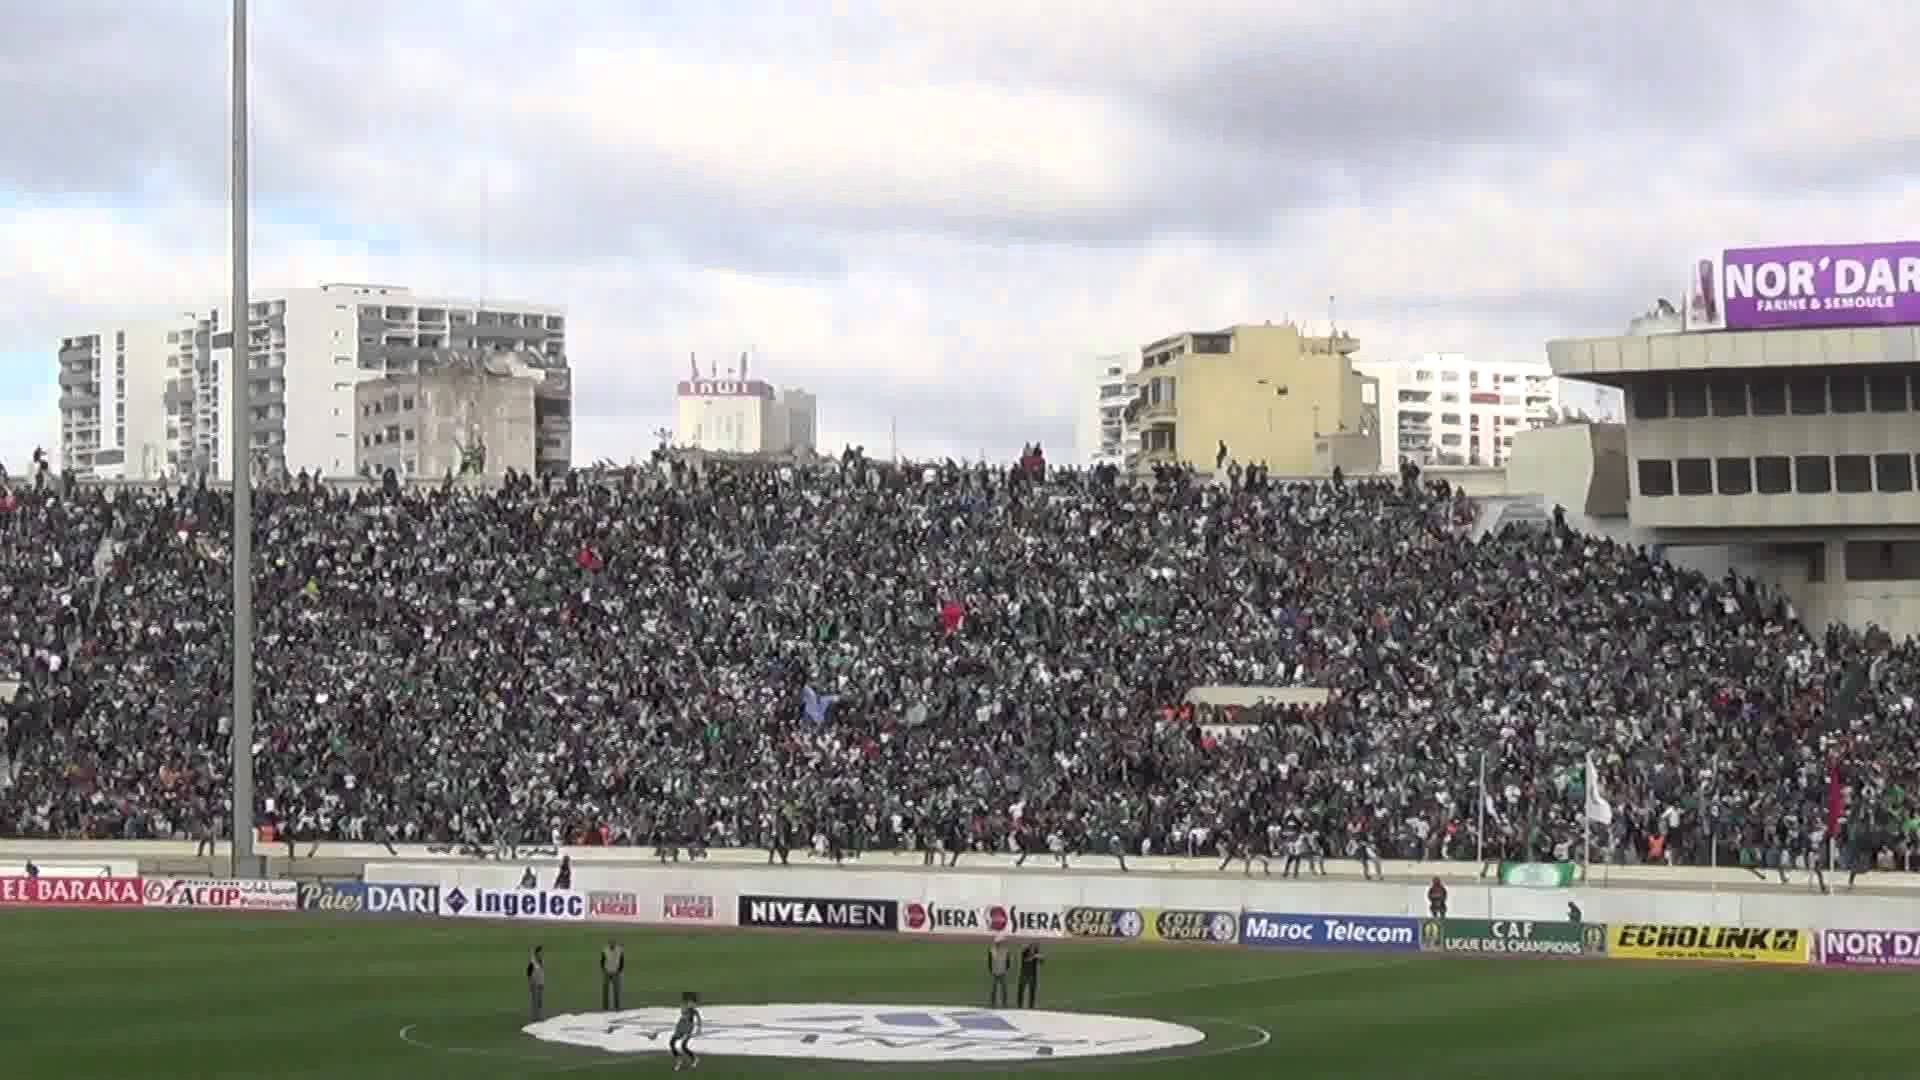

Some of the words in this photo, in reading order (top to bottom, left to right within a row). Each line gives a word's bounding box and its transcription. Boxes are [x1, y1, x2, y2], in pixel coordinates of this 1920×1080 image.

[1757, 298, 1806, 311] FARINE
[1810, 298, 1821, 310] &
[1824, 296, 1894, 310] SEMOULE
[2, 879, 31, 900] EL
[38, 879, 137, 902] BARAKA
[367, 887, 435, 912] DARI
[751, 900, 824, 924] NIVEA
[826, 904, 886, 926] MEN
[1246, 917, 1312, 940] Maroc
[1325, 919, 1413, 943] Telecom
[1618, 924, 1771, 951] ECHOLINK
[1482, 938, 1506, 952] DES
